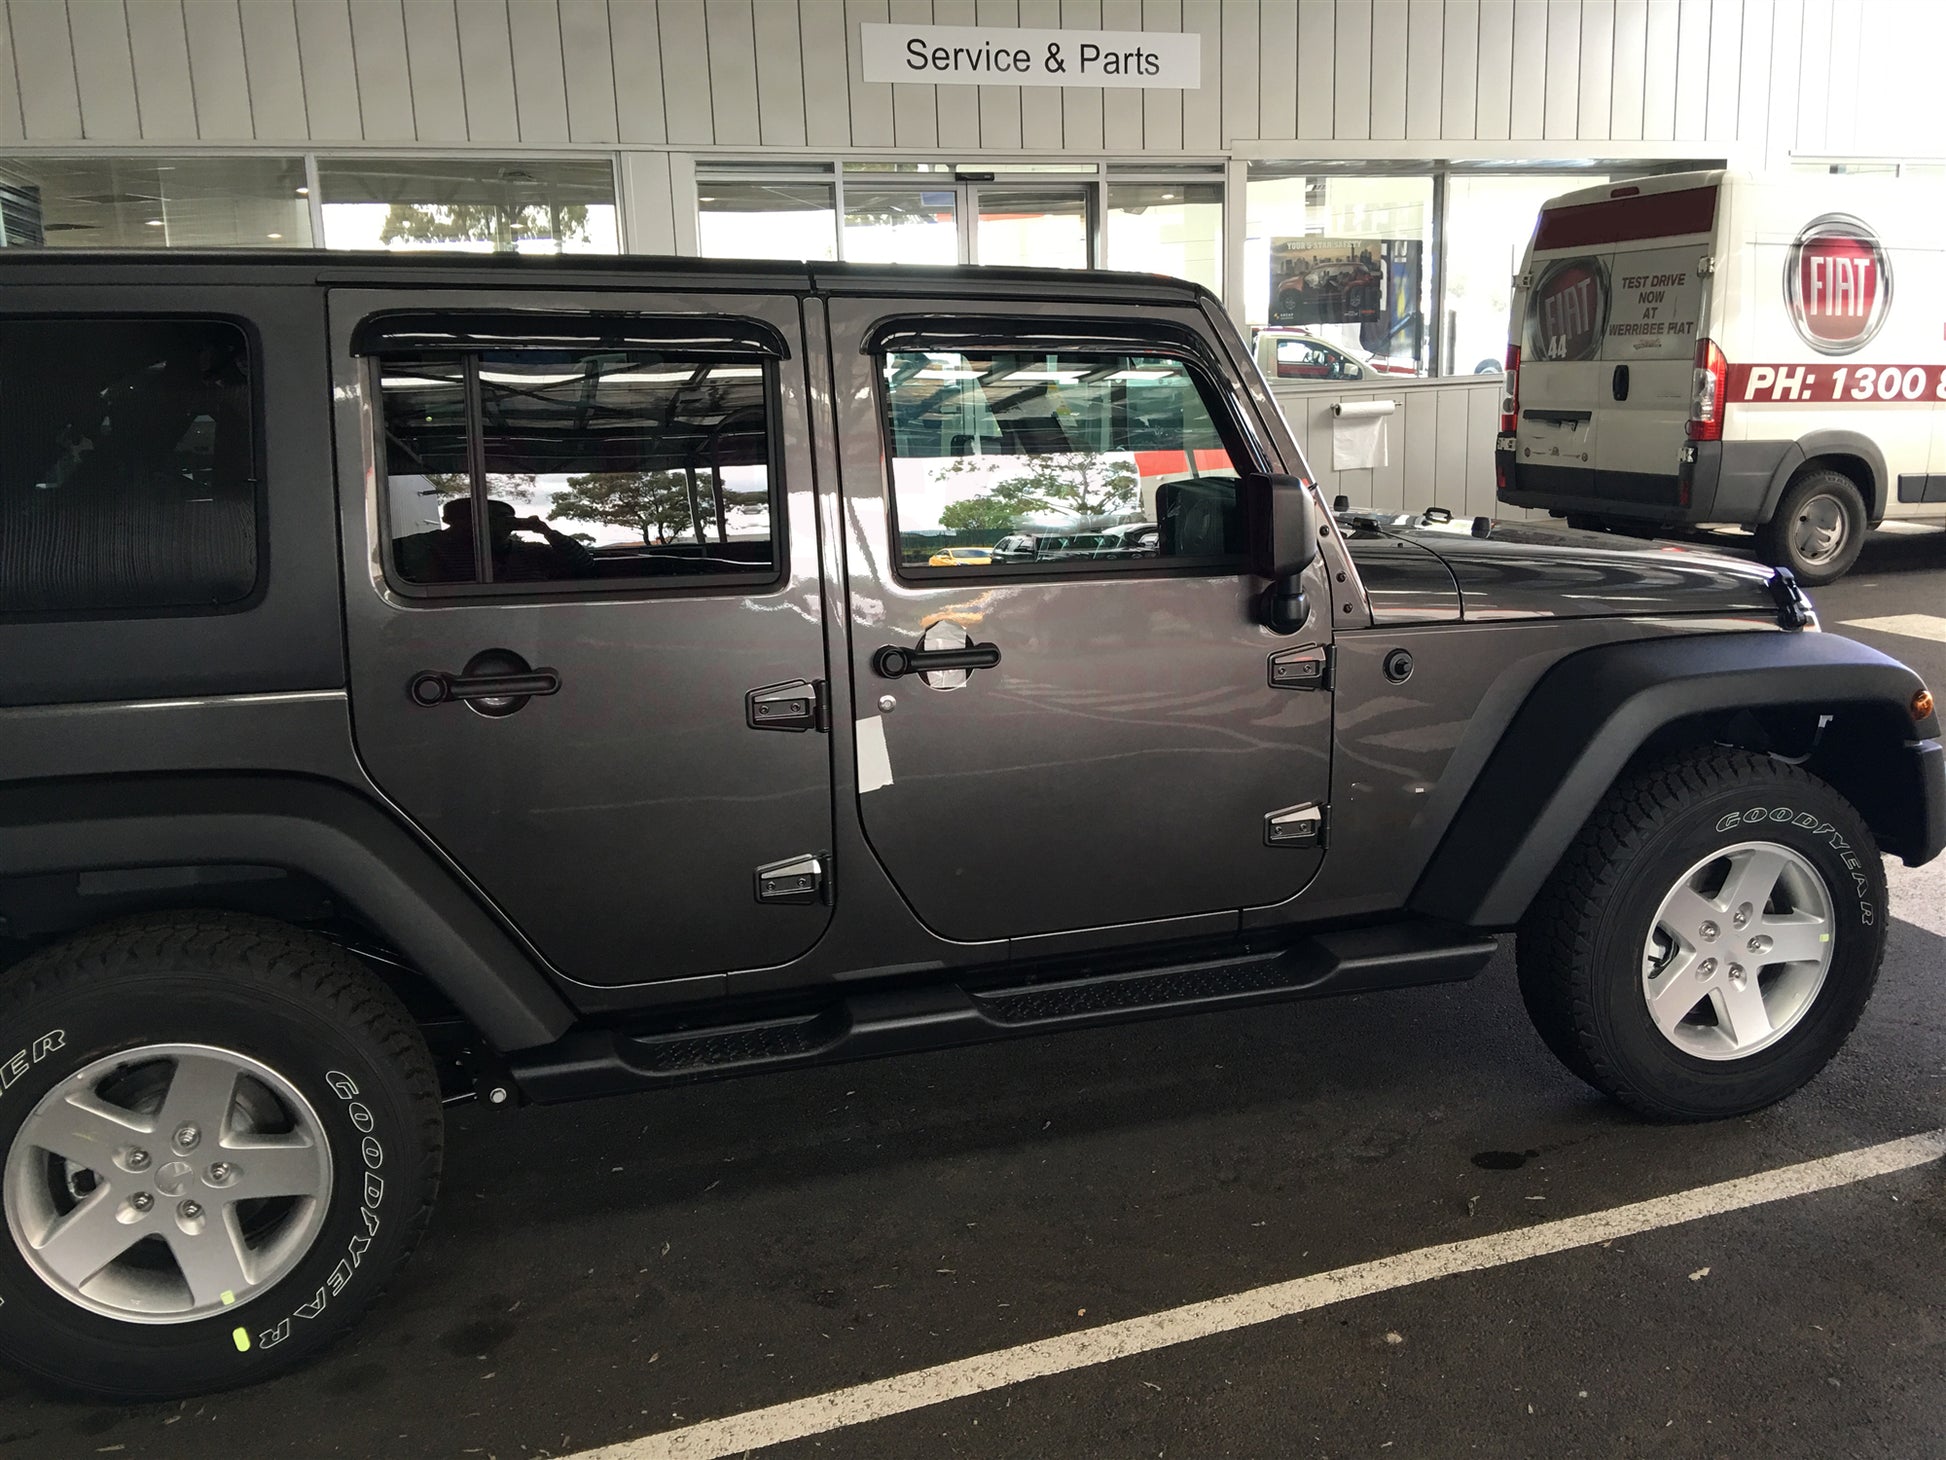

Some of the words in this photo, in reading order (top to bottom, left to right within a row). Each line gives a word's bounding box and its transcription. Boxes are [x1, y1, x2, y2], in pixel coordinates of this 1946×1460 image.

[906, 38, 1031, 73] Service
[1044, 42, 1066, 73] &
[1080, 43, 1161, 76] Parts
[1287, 241, 1306, 250] YOUR
[1621, 276, 1649, 289] TEST
[1650, 273, 1686, 288] DRIVE
[1638, 291, 1665, 304] NOW
[1809, 256, 1871, 317] FIAT
[1544, 277, 1591, 340] FIAT
[1642, 307, 1658, 320] AT
[1608, 322, 1665, 336] WERRIBEE
[1666, 321, 1694, 335] FIAT
[1548, 334, 1567, 359] 44
[1744, 366, 1816, 400] PH:
[1831, 367, 1927, 400] 1300
[1715, 807, 1874, 926] GOODYEAR
[0, 1029, 66, 1094] ER
[259, 1070, 385, 1349] GOODYEAR
